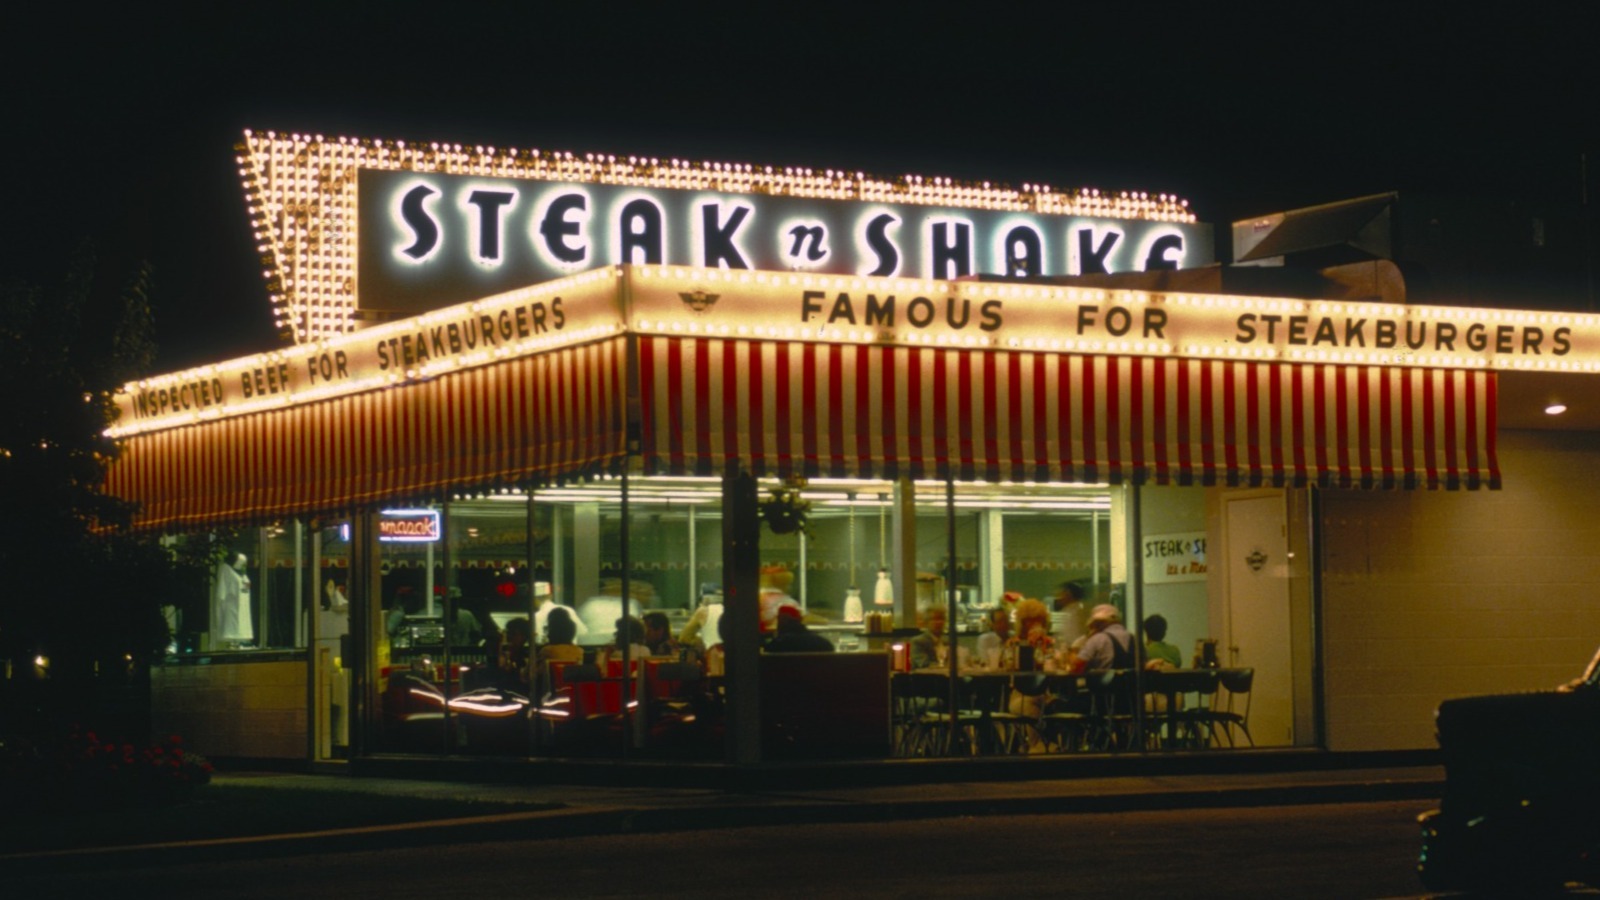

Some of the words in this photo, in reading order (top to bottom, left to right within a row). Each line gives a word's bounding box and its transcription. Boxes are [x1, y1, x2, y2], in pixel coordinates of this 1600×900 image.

[400, 184, 752, 270] STEAK
[787, 224, 829, 262] n
[865, 213, 1183, 279] SHAKE
[132, 378, 224, 419] INSPECTED
[241, 362, 289, 399] BEEF
[308, 350, 349, 386] FOR
[377, 296, 566, 370] STEAKBURGERS
[801, 290, 1003, 331] FAMOUS
[1076, 305, 1169, 339] FOR
[1235, 312, 1572, 356] STEAKBURGERS
[1146, 540, 1184, 558] STEAK
